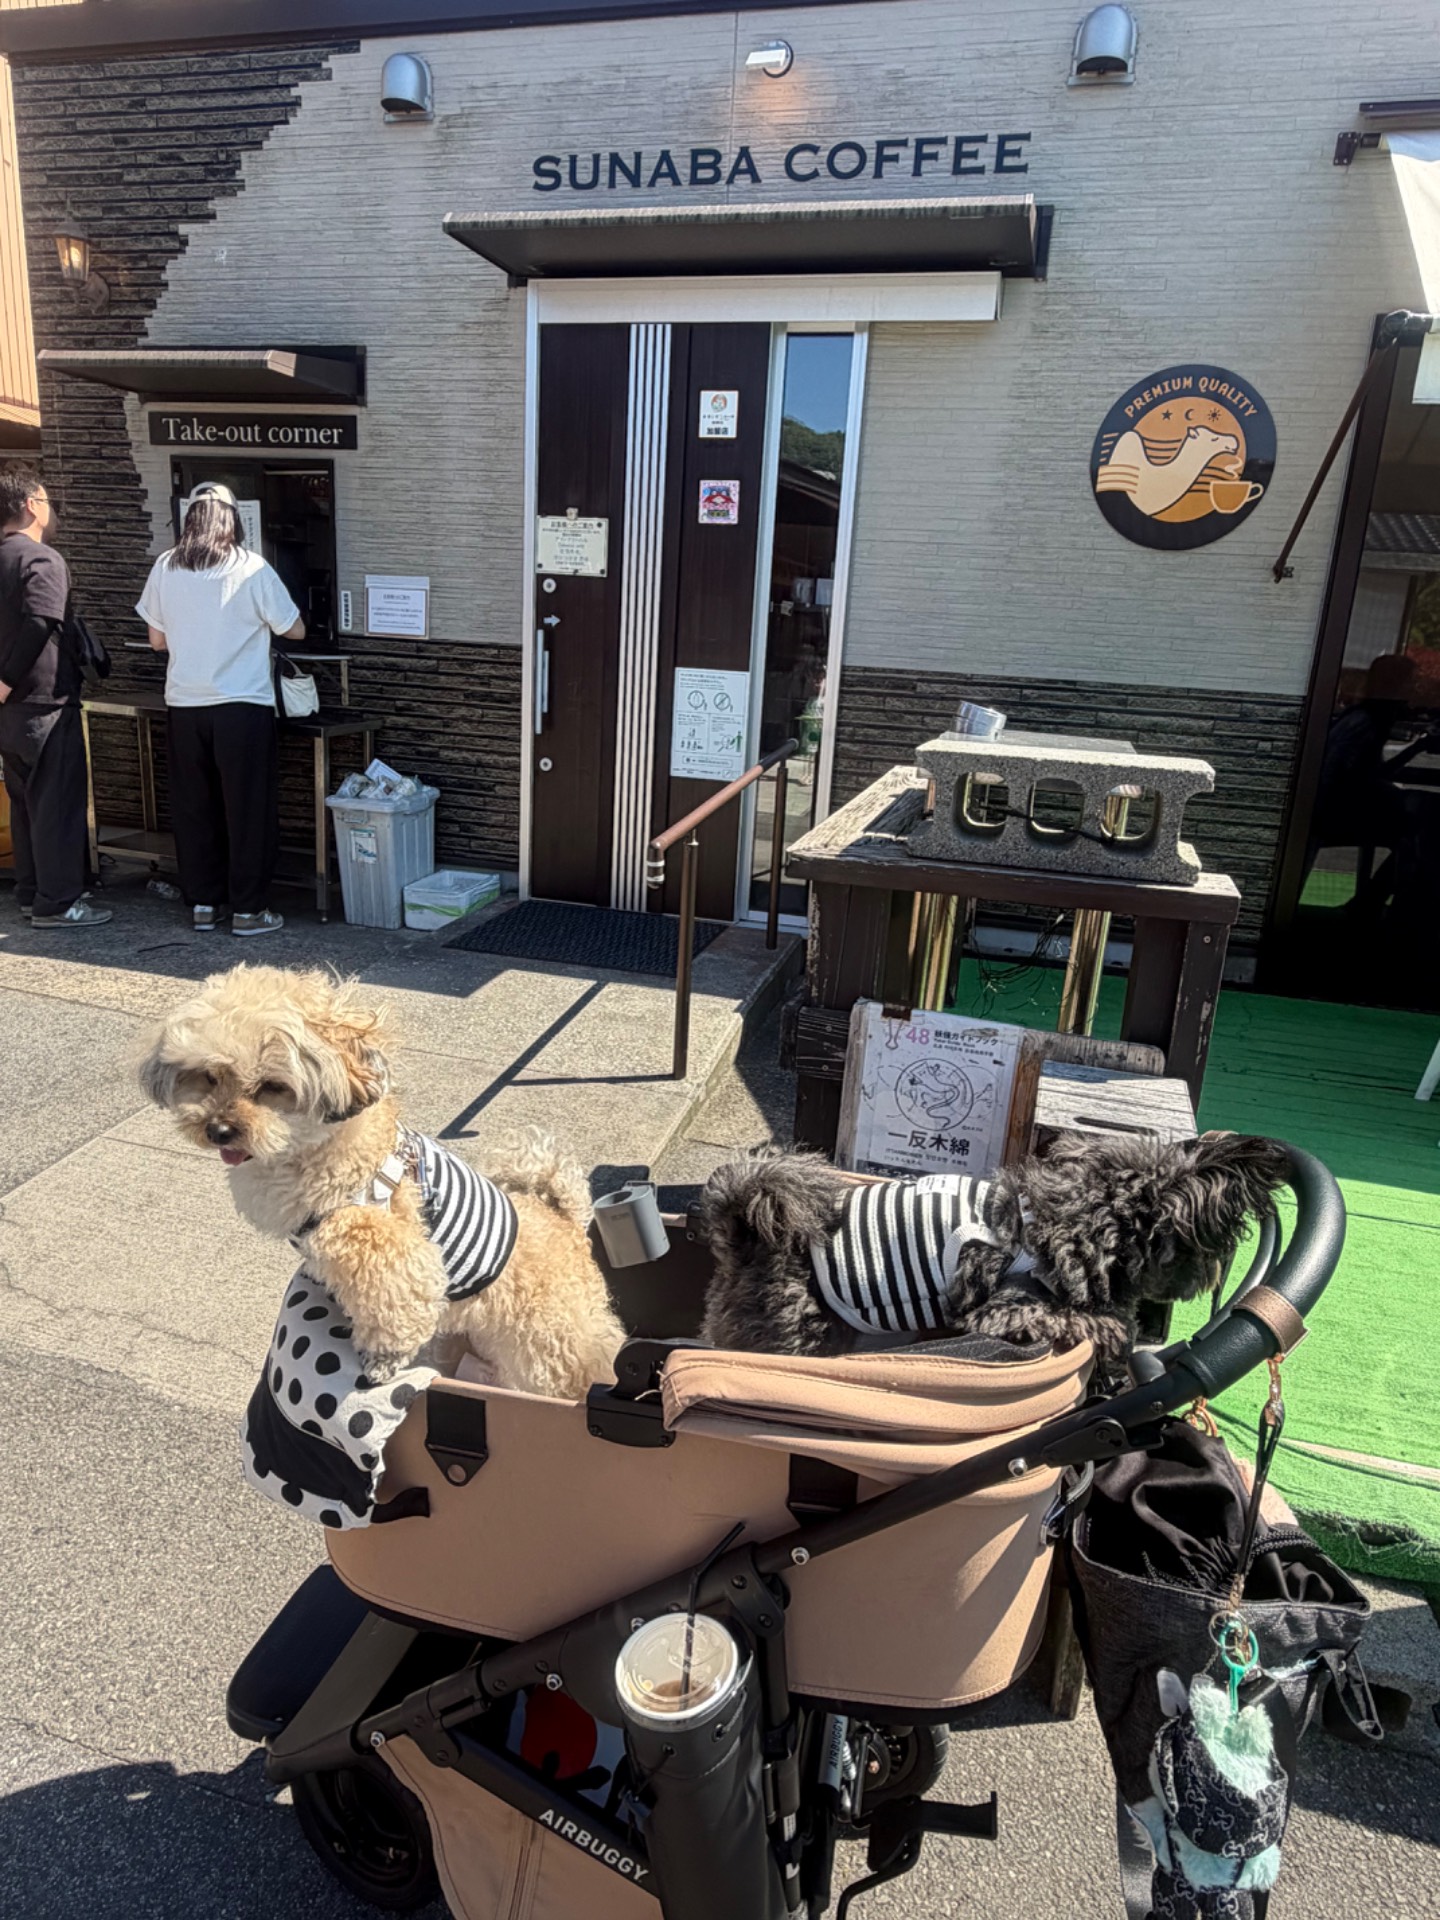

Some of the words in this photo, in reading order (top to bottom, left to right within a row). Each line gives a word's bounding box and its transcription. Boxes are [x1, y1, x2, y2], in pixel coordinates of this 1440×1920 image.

[532, 146, 762, 192] SUNABA
[784, 132, 1032, 183] COFFEE
[1124, 376, 1194, 418] PREMIUM
[1198, 376, 1258, 418] QUALITY
[161, 418, 262, 443] Take-out
[268, 425, 344, 445] corner
[905, 1026, 930, 1045] 48
[887, 1129, 971, 1157] 一反木綿
[828, 1718, 845, 1770] AIRBUGGY
[538, 1808, 650, 1882] AIRBUGGY
